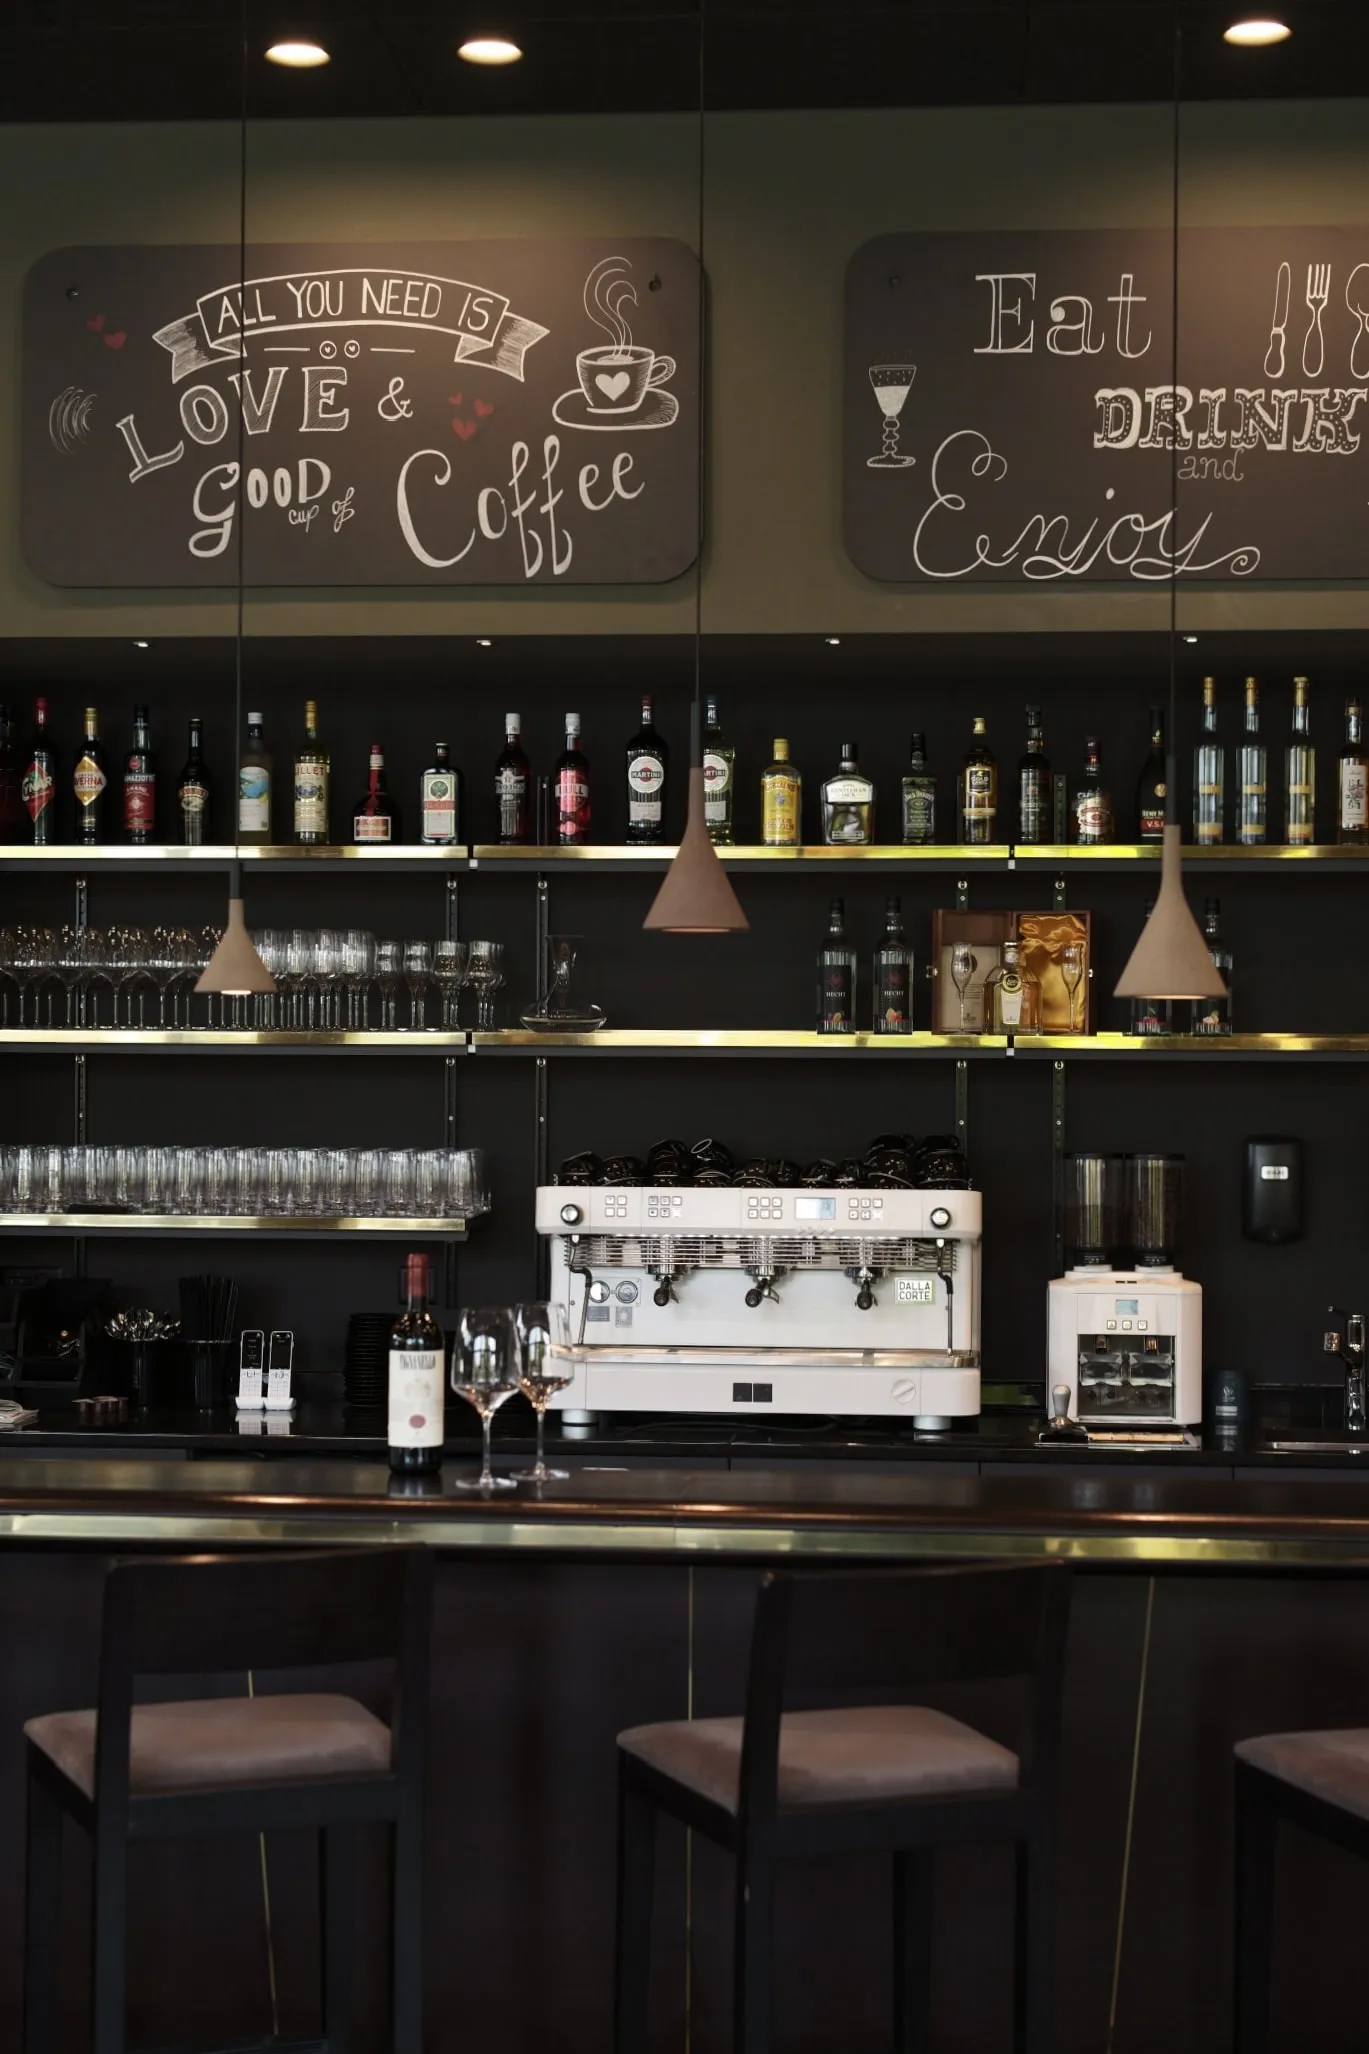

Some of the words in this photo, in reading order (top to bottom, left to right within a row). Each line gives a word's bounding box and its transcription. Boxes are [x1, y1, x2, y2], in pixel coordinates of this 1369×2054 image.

[217, 294, 276, 334] ALL
[287, 279, 343, 318] YOU
[361, 279, 441, 318] NEED
[458, 291, 494, 332] IS
[973, 272, 1152, 358] Eat
[115, 366, 350, 483] LOVE
[377, 376, 414, 422] &
[1093, 385, 1369, 455] DRINK
[1177, 448, 1245, 481] and
[331, 486, 356, 533] of
[396, 434, 646, 578] Coffee
[913, 429, 1261, 580] Enjoy
[631, 770, 661, 779] MARTINI
[703, 769, 725, 778] ARTINI
[899, 1281, 931, 1291] DALLA
[899, 1291, 931, 1300] CORTE
